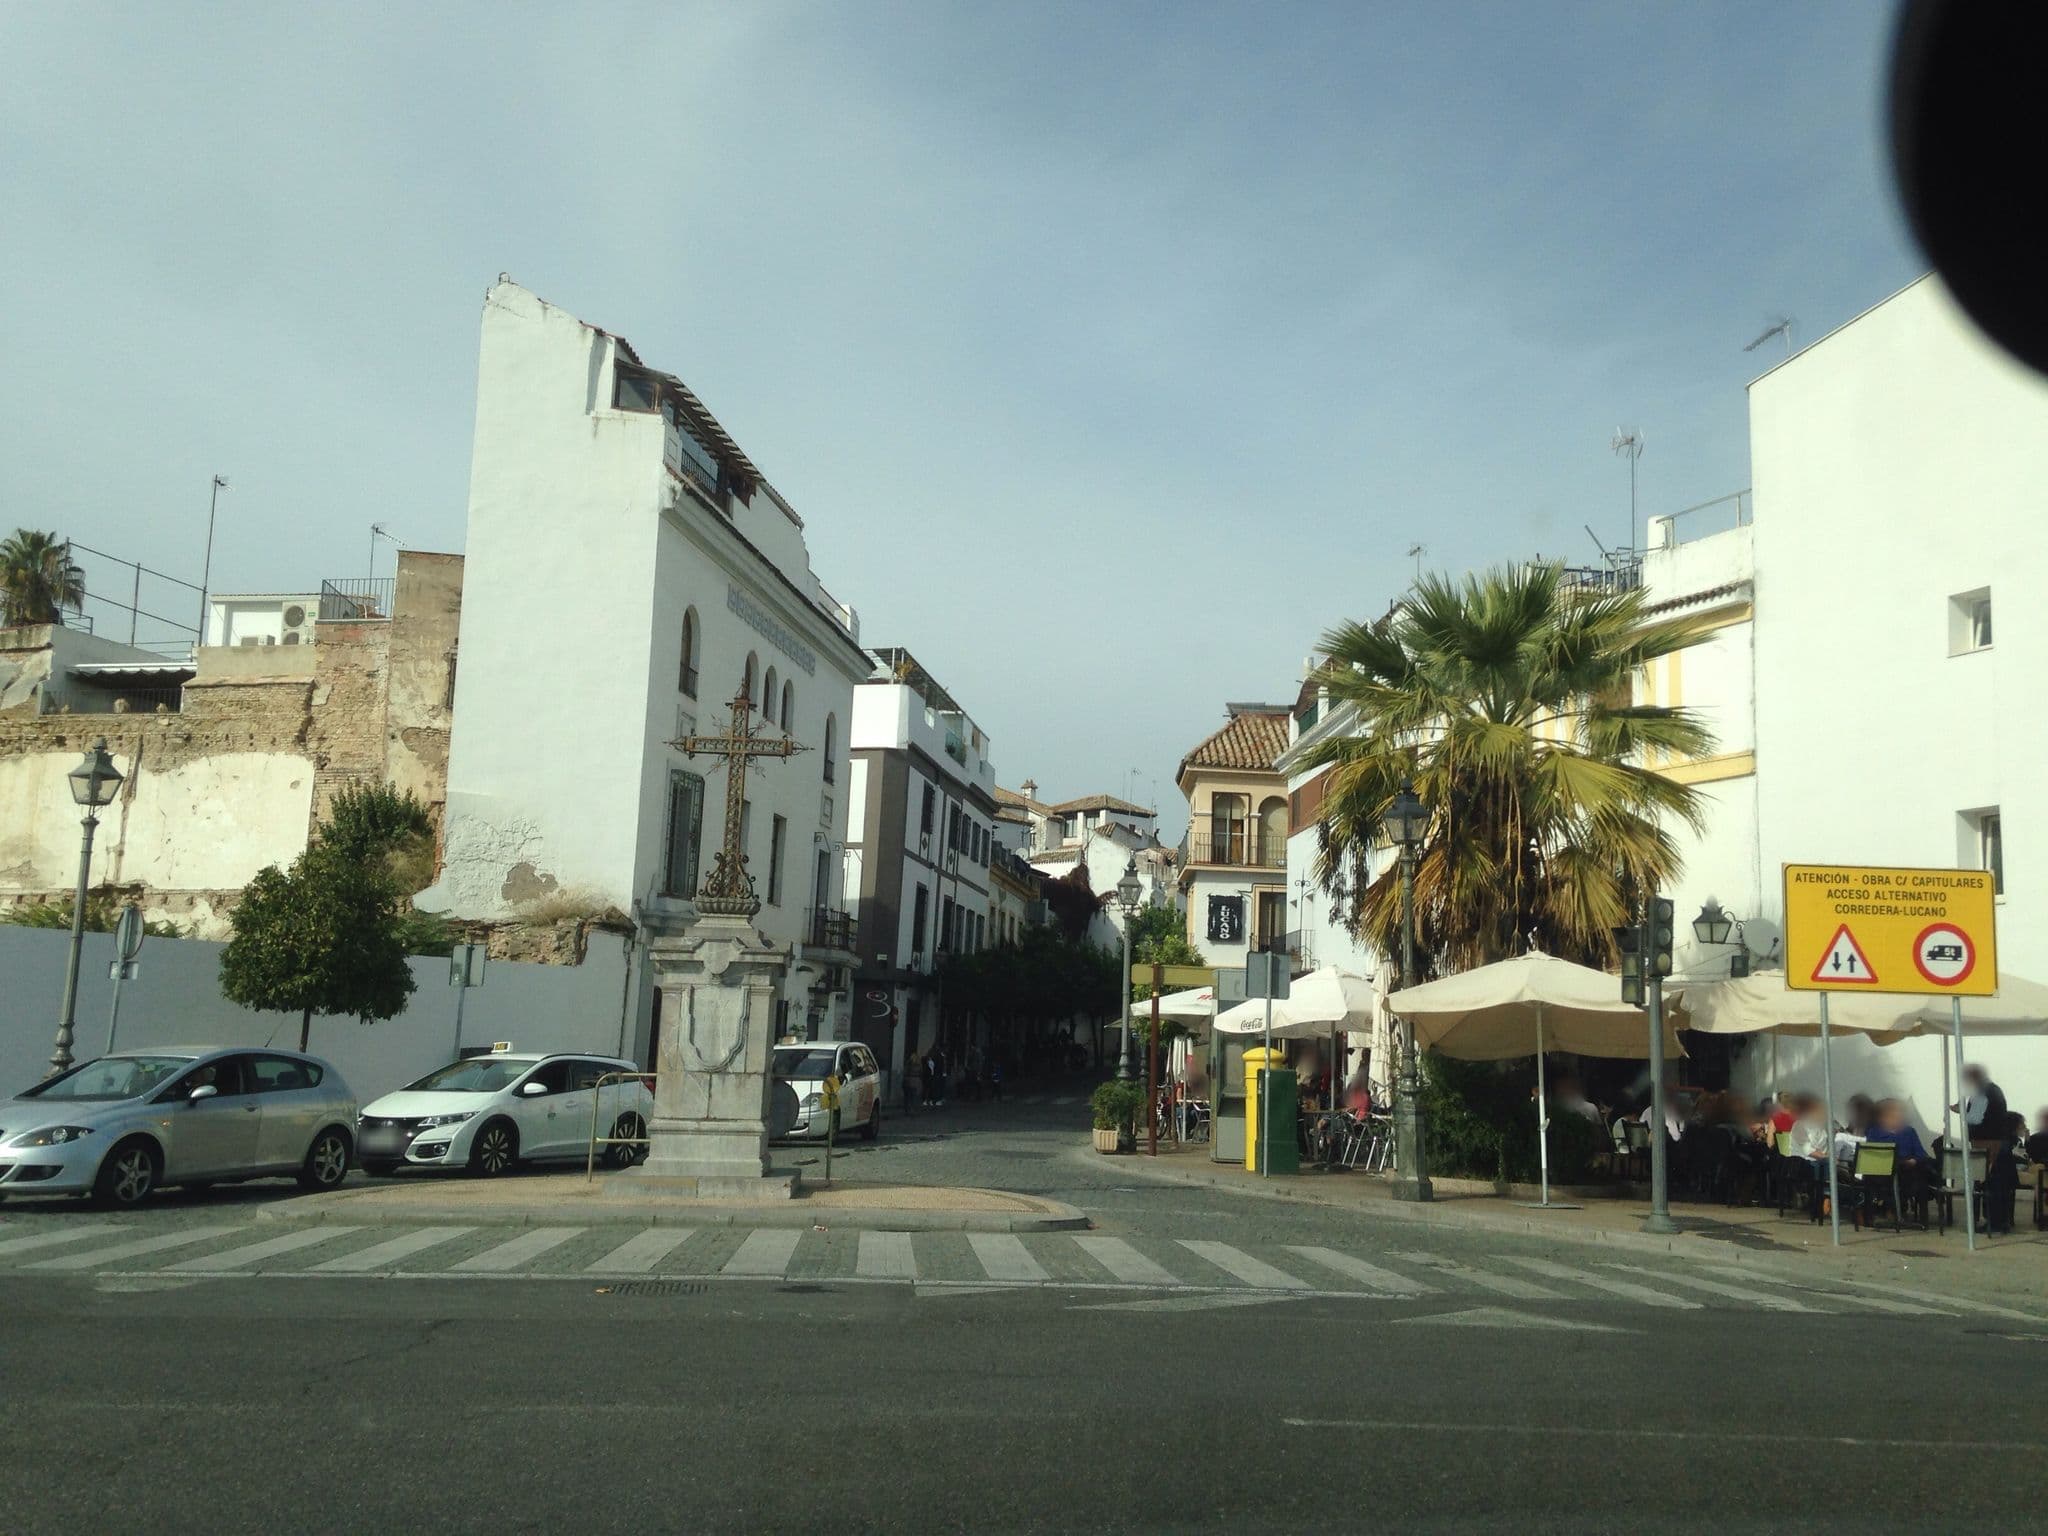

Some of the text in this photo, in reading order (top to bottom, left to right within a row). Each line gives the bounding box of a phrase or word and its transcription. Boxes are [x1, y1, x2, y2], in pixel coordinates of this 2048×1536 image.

[1795, 872, 1850, 884] ATENCIÓN
[1862, 874, 1891, 885] OBRA
[1895, 875, 1908, 886] C/
[1911, 876, 1984, 889] CAPITULARES
[1827, 889, 1947, 903] ACCESO ALTERNATIVO
[1834, 904, 1947, 917] CORREDERA-LUCANO
